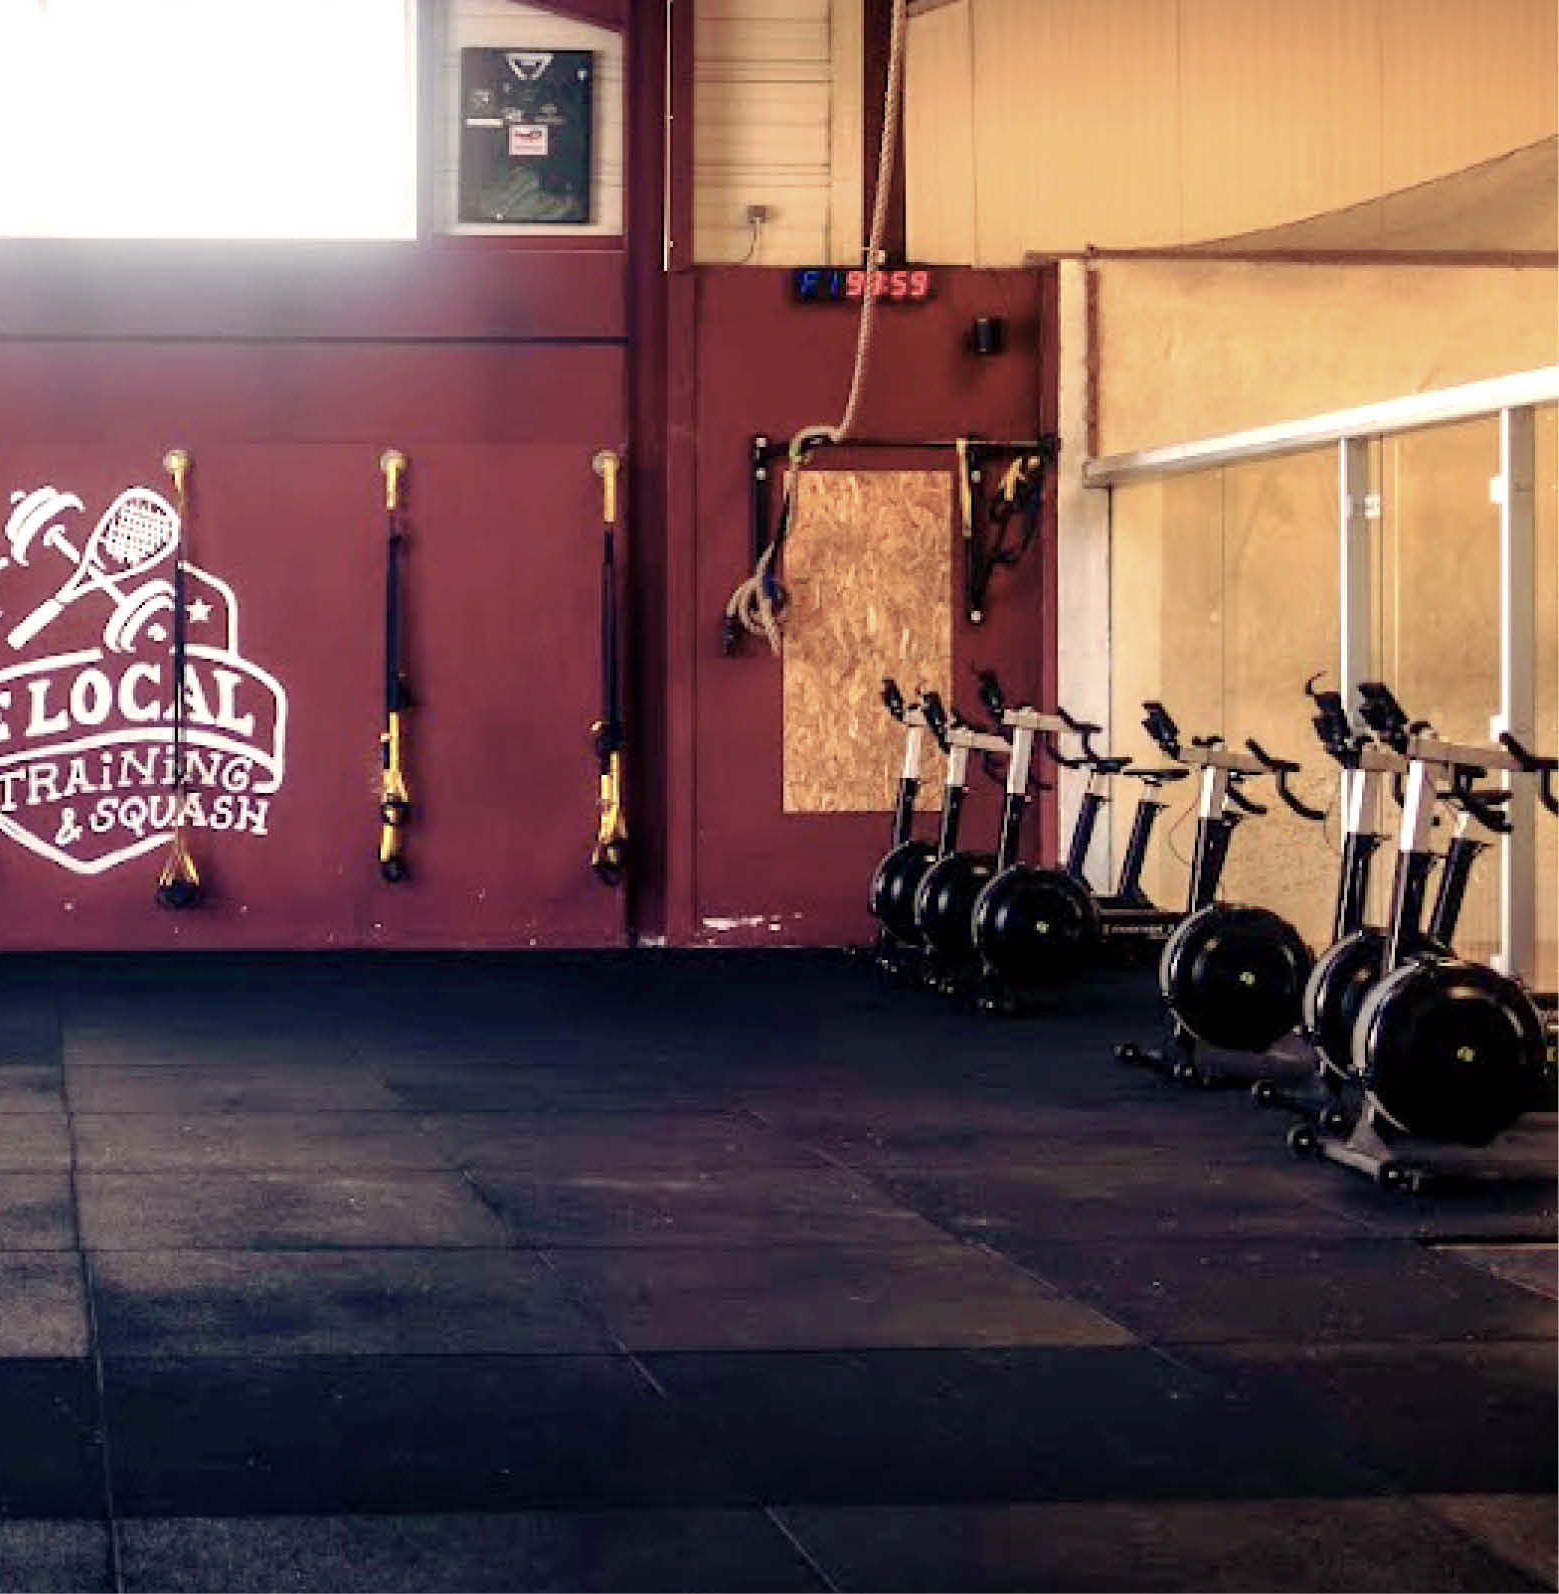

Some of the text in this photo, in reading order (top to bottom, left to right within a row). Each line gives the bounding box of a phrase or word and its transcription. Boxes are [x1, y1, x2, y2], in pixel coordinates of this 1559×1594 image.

[25, 662, 255, 737] LOCAL
[54, 792, 269, 847] & SQUASH
